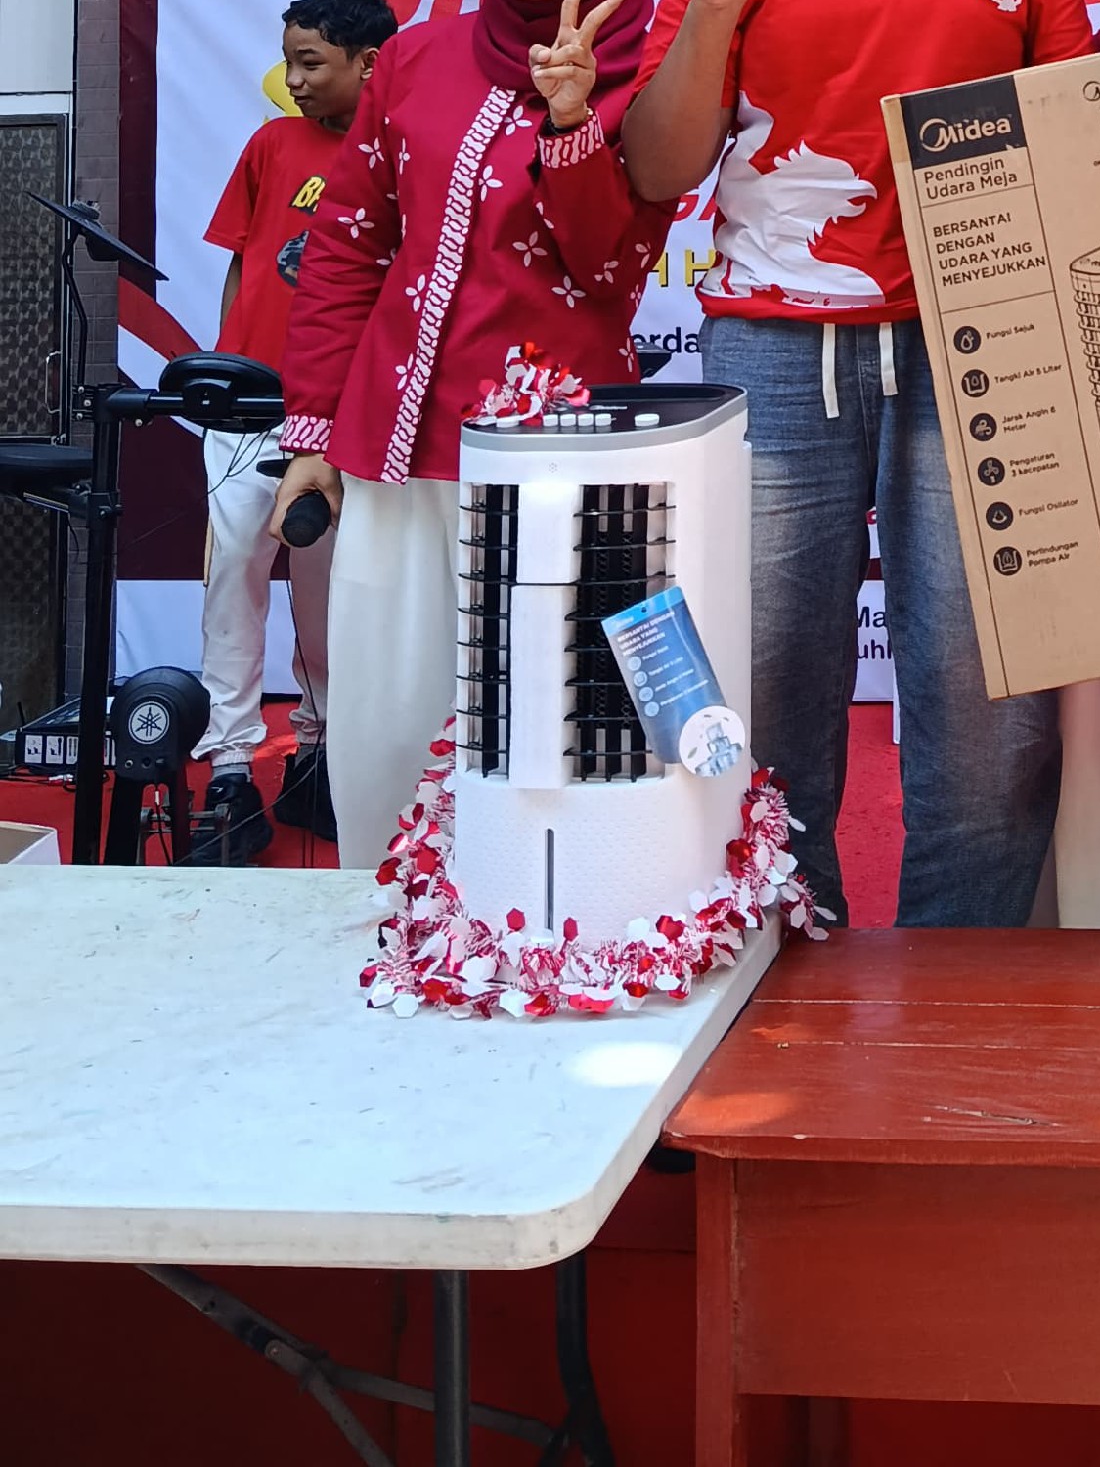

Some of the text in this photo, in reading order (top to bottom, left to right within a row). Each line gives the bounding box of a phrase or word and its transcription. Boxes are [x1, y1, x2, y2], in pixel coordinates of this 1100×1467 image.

[919, 117, 1012, 152] Midea
[923, 157, 1005, 184] Pendingin
[926, 171, 1018, 200] Udara Meja
[933, 212, 1012, 238] BERSANTAI
[936, 232, 996, 254] DENGAN
[939, 242, 1033, 270] UDARA YANG
[942, 255, 1046, 287] MENYEJUKKAN
